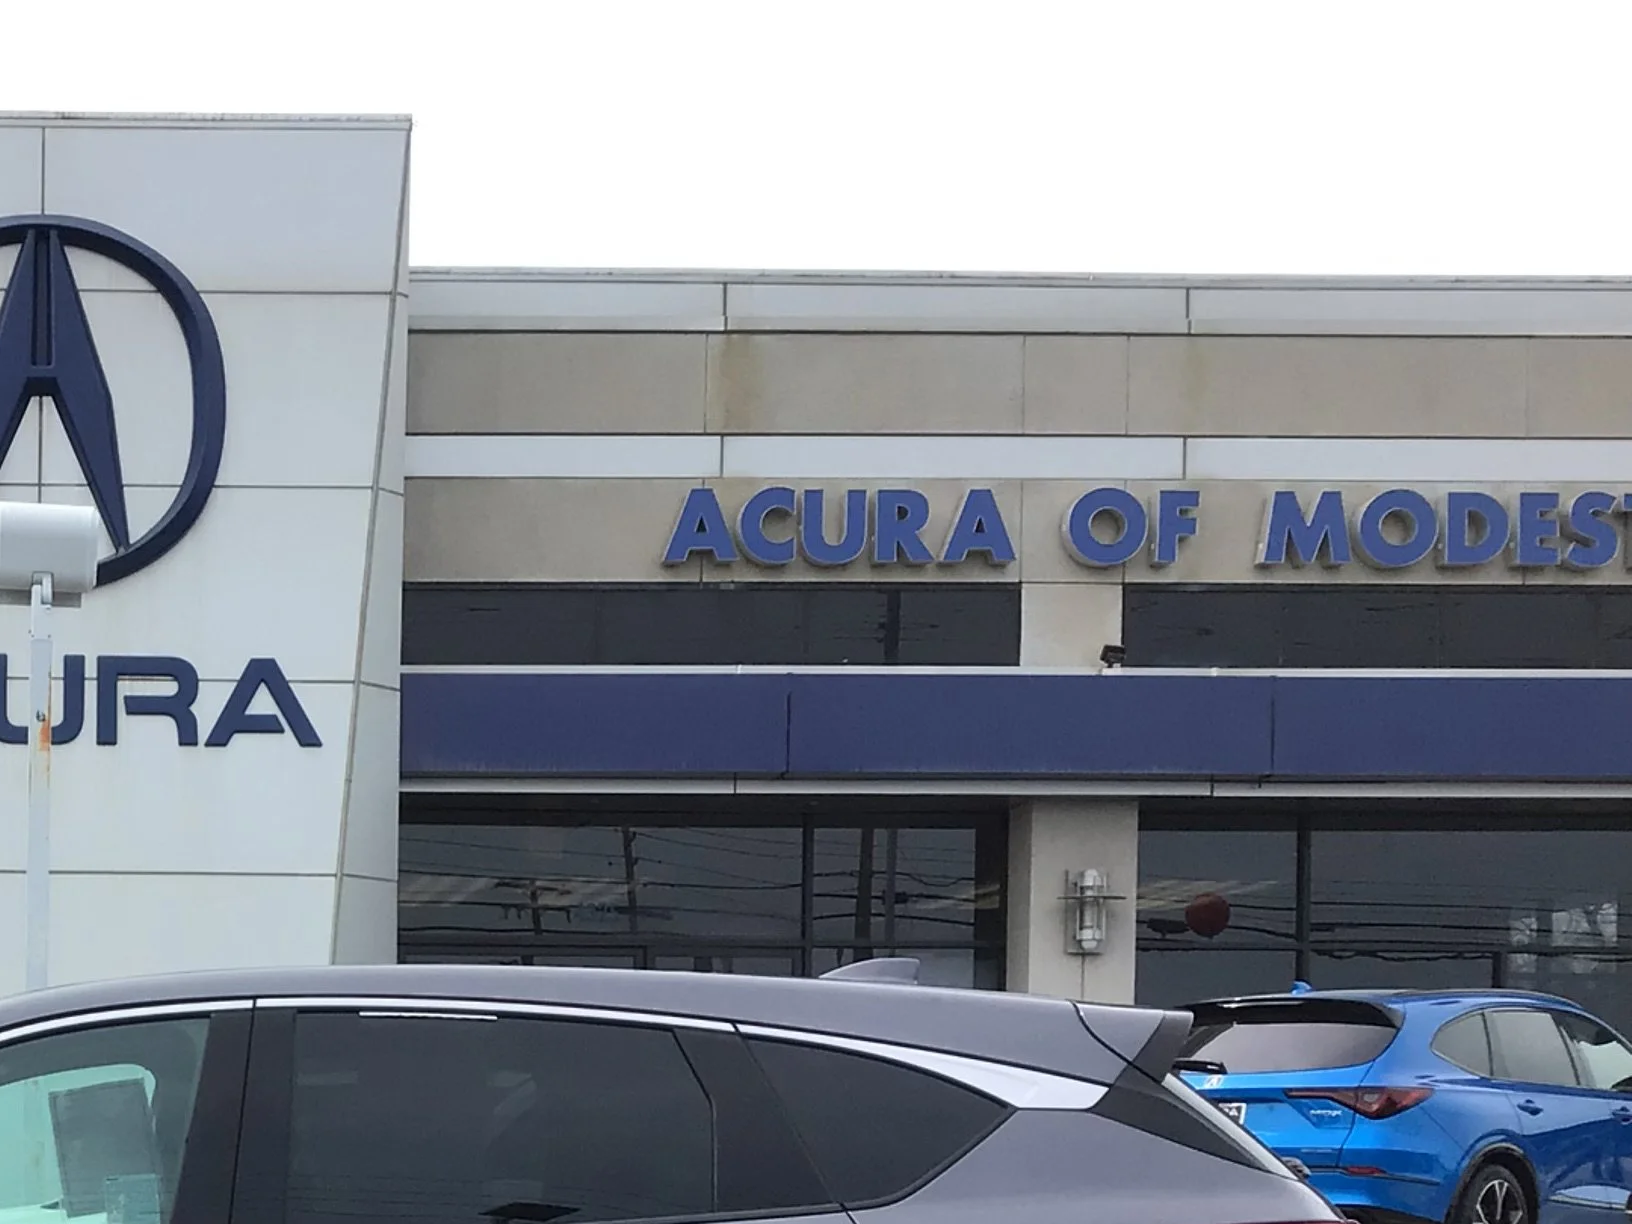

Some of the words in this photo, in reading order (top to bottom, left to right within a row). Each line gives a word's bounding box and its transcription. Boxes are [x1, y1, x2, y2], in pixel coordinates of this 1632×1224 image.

[662, 486, 1017, 565] ACURA
[1061, 487, 1200, 566] OF
[1256, 487, 1632, 567] MODES
